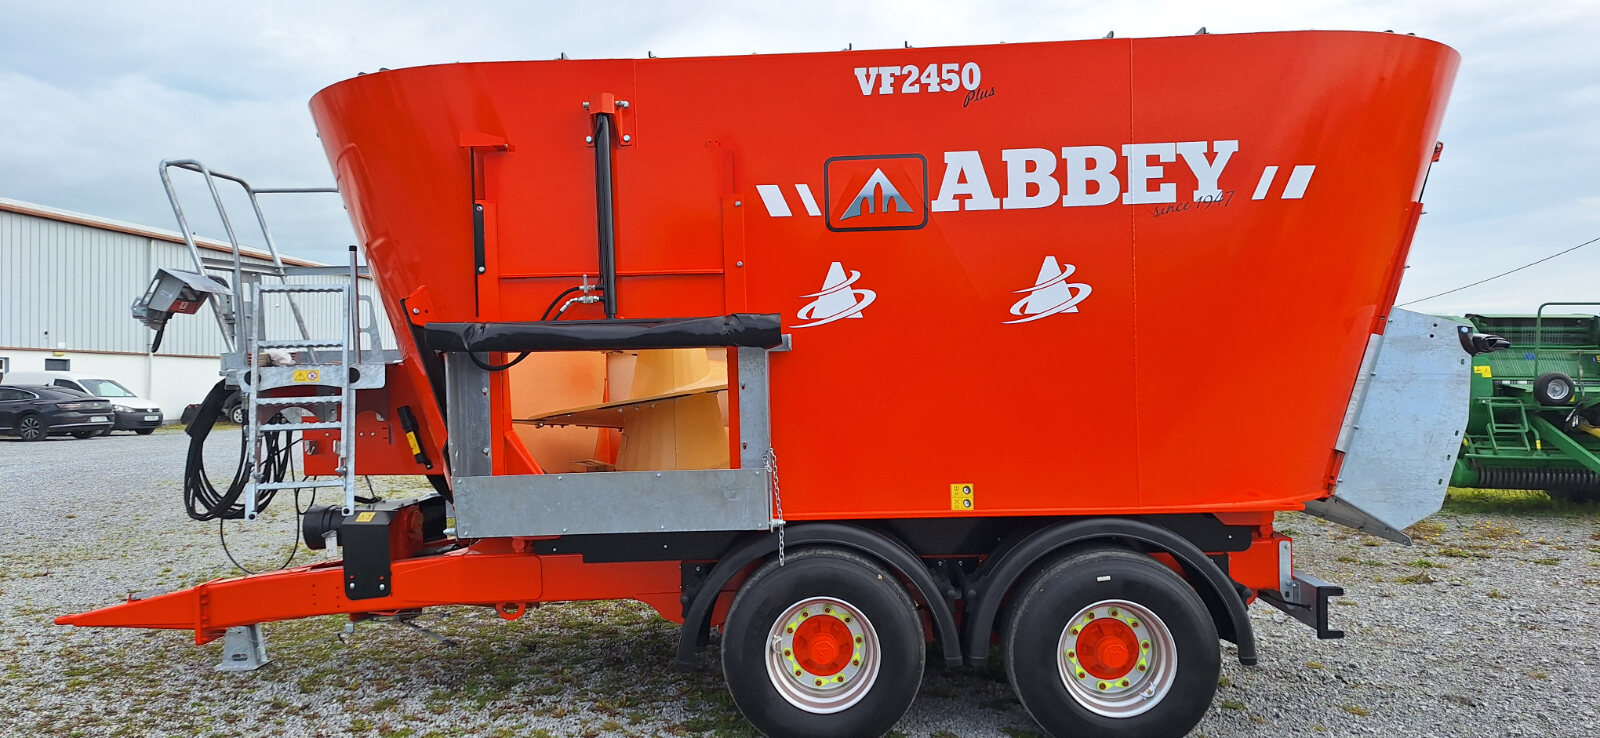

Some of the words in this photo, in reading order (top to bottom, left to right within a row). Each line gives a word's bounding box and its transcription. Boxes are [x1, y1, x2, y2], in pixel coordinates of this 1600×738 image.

[854, 61, 982, 96] VF2450
[963, 87, 996, 108] Plus
[931, 139, 1239, 212] ABBEY
[1152, 201, 1191, 218] since
[1196, 190, 1236, 211] 1947
